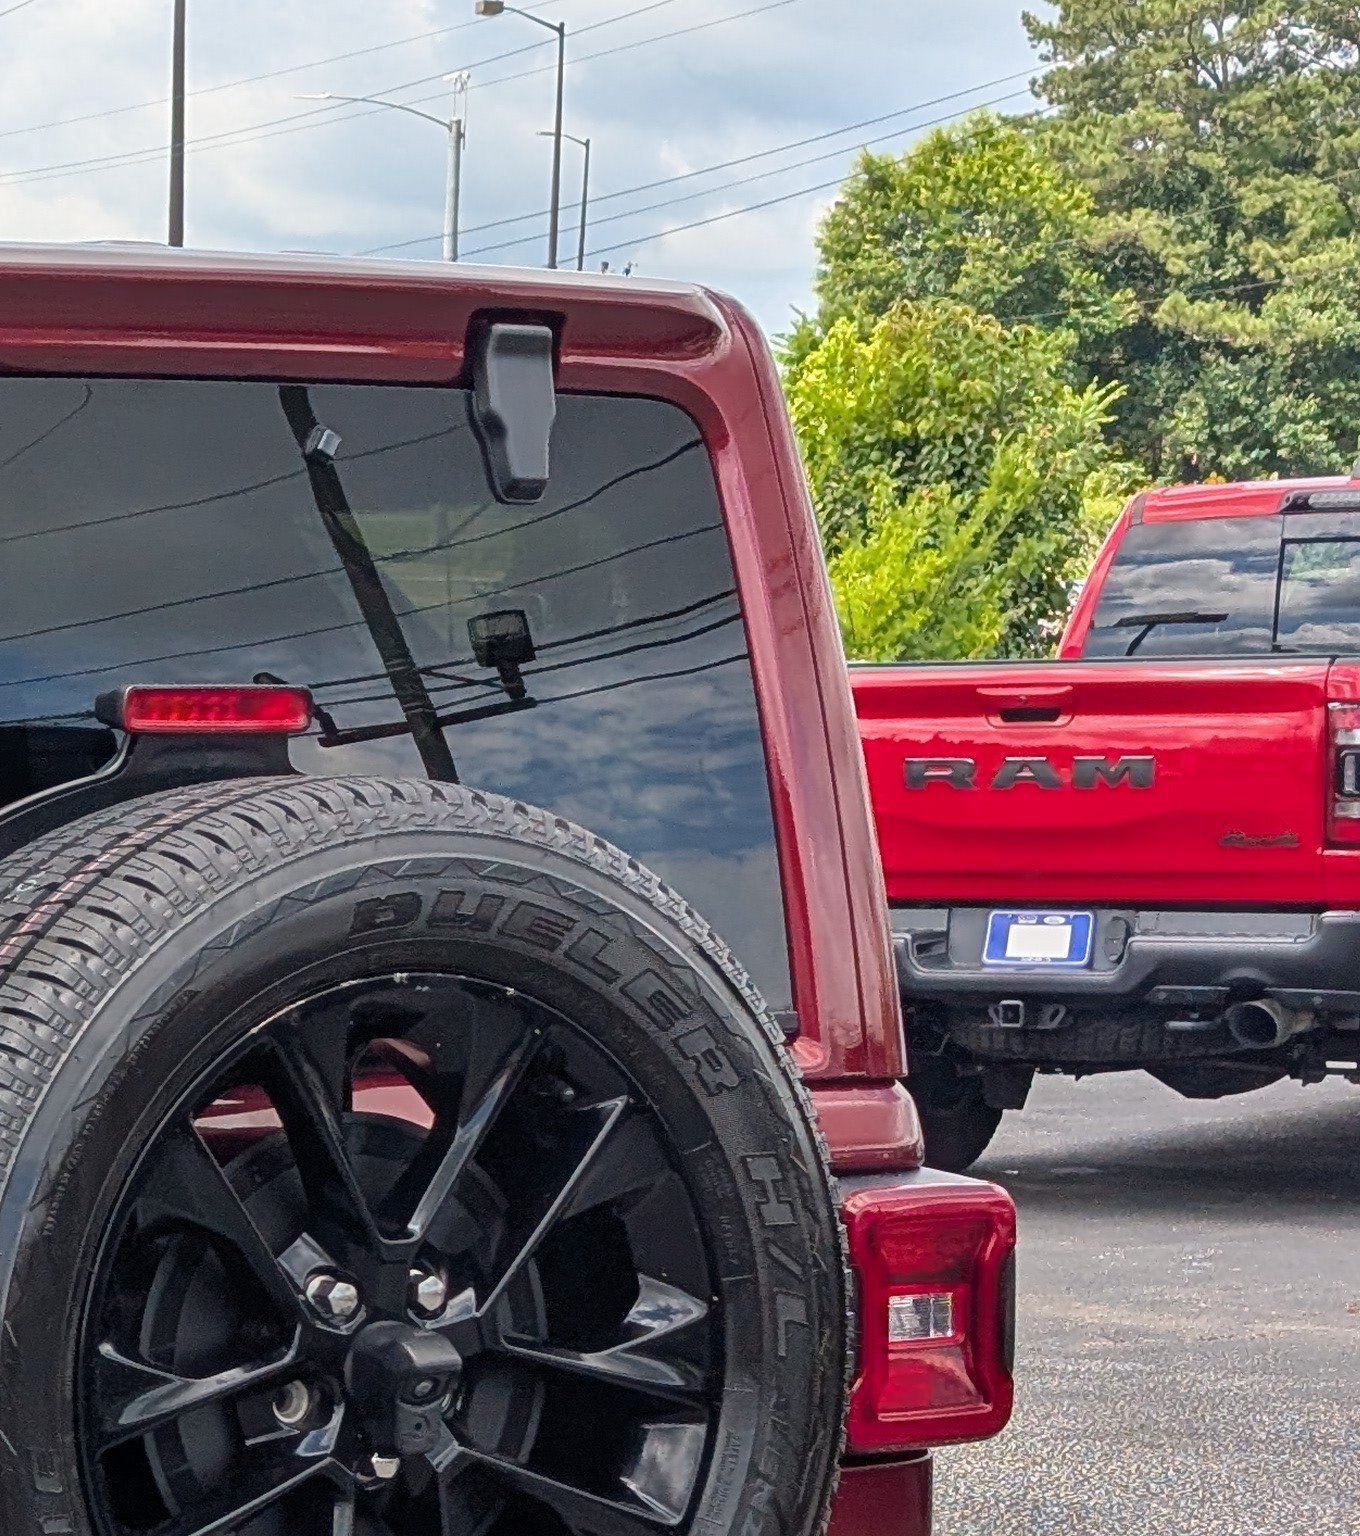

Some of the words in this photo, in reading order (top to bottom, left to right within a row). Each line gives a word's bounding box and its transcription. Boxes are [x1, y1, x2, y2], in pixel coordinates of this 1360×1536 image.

[903, 755, 1156, 790] RAM
[350, 888, 745, 1097] DUELER
[740, 1152, 811, 1358] H/L
